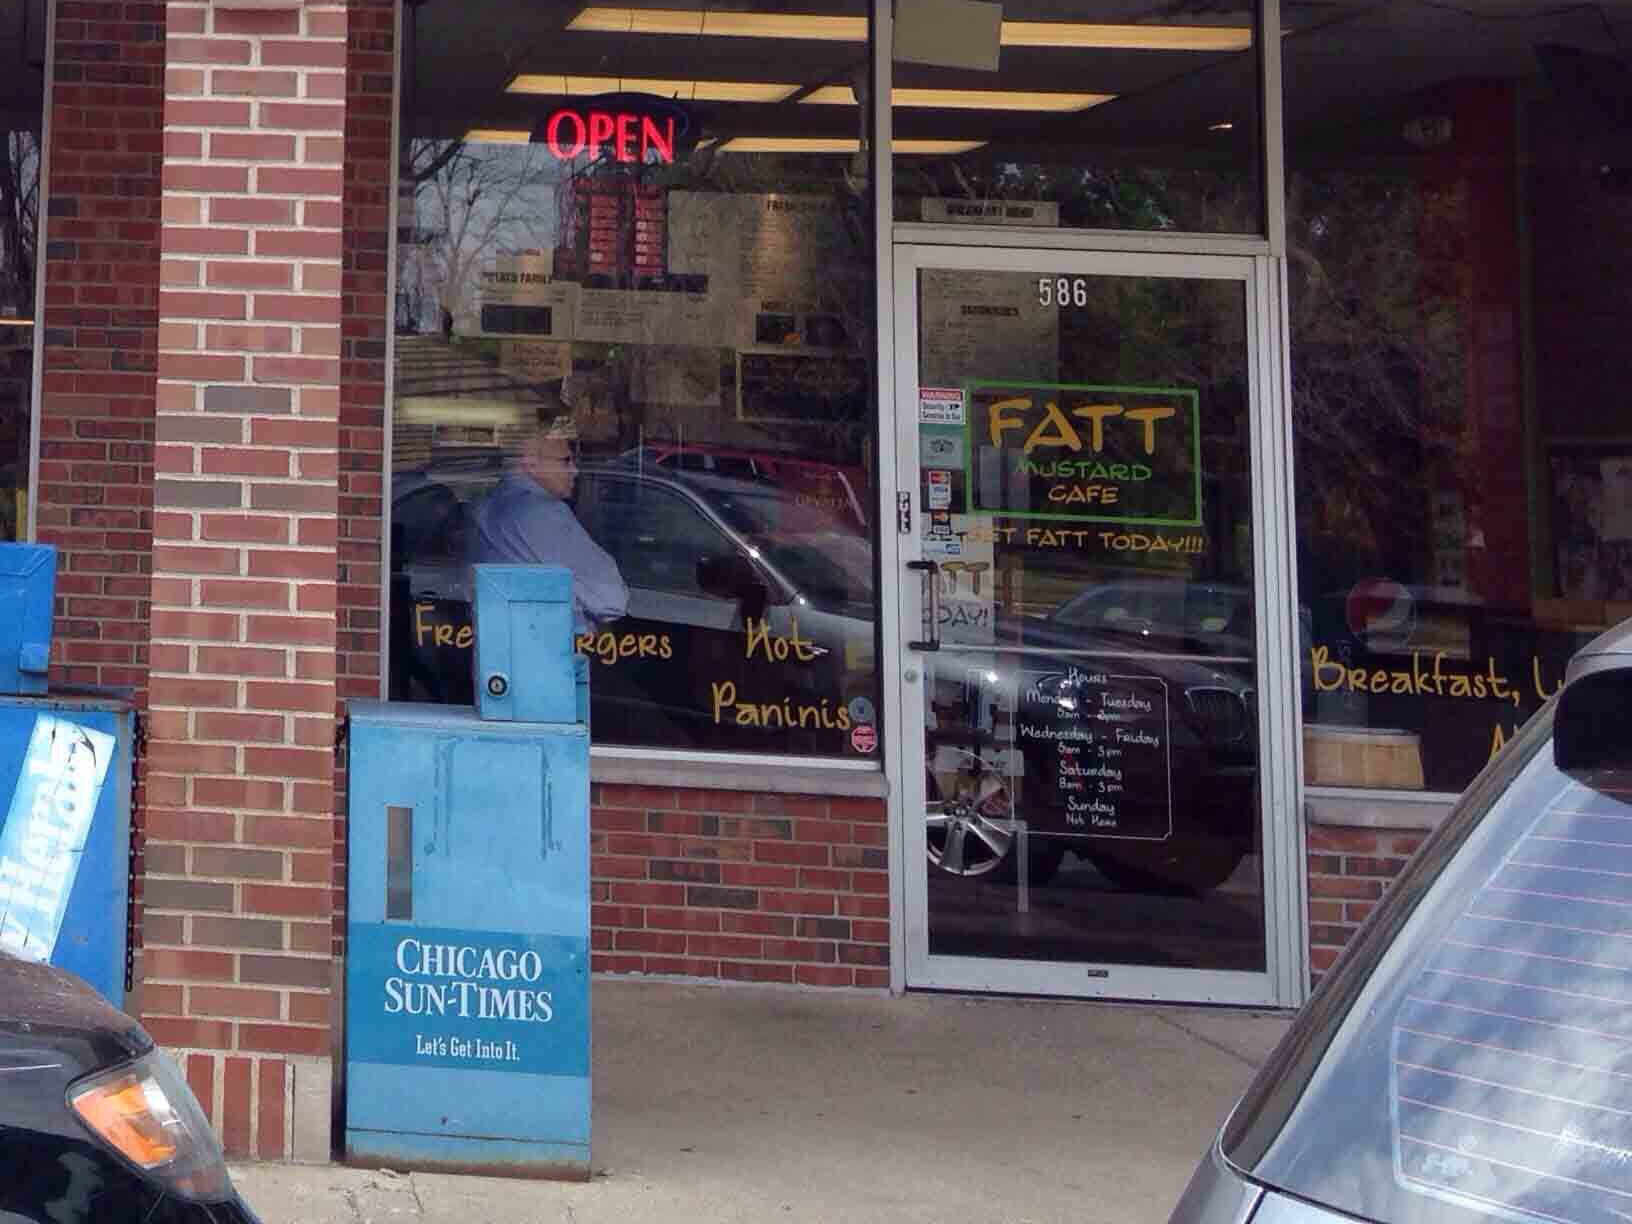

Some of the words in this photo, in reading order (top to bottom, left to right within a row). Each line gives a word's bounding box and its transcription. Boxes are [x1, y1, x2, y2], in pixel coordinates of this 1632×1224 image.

[547, 109, 674, 164] OPEN
[1039, 278, 1088, 307] 586
[988, 395, 1175, 455] FATT
[1016, 460, 1152, 481] MUSTARD
[1048, 484, 1119, 505] CAFE
[1026, 528, 1088, 547] FATT
[1098, 532, 1205, 553] TODAY!!!
[415, 603, 474, 648] Fre
[575, 631, 673, 665] rgers
[746, 616, 817, 663] Hot
[1311, 645, 1521, 707] Breakfast,
[712, 680, 851, 730] Paninis
[1059, 760, 1122, 781] Saturday
[1068, 796, 1116, 816] Sunday
[396, 938, 543, 982] CHICAGO
[384, 977, 553, 1023] SUN-TIMES
[416, 1034, 447, 1057] Let's
[450, 1037, 472, 1058] Get
[476, 1039, 503, 1060] Into
[505, 1041, 521, 1062] It.
